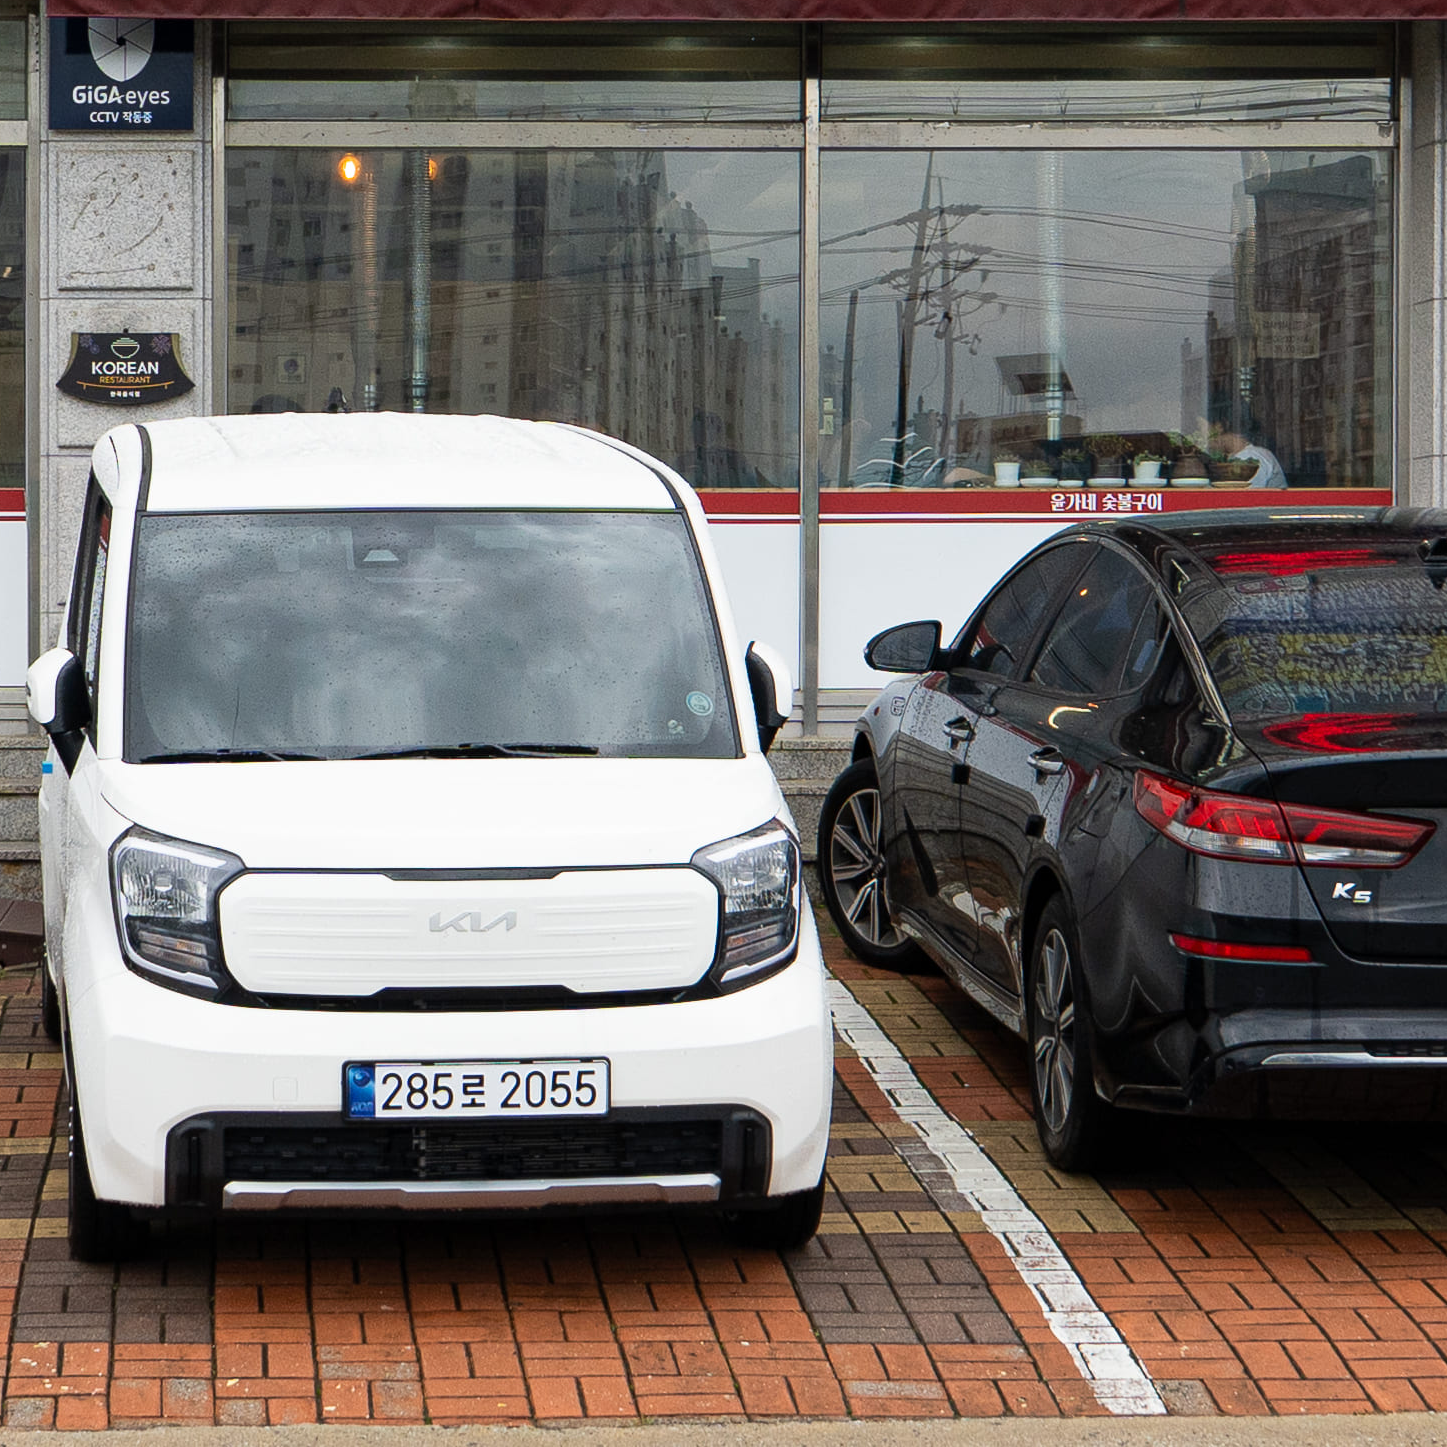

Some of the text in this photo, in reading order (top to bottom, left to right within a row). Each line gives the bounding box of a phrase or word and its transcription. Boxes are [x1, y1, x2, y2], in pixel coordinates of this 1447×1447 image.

[89, 111, 153, 124] CCTV 작동중
[91, 361, 159, 375] KOREAN
[99, 376, 151, 384] RESTAURANT
[1050, 493, 1163, 511] 윤가네 숯불구이
[381, 1070, 597, 1111] 285로 2055
